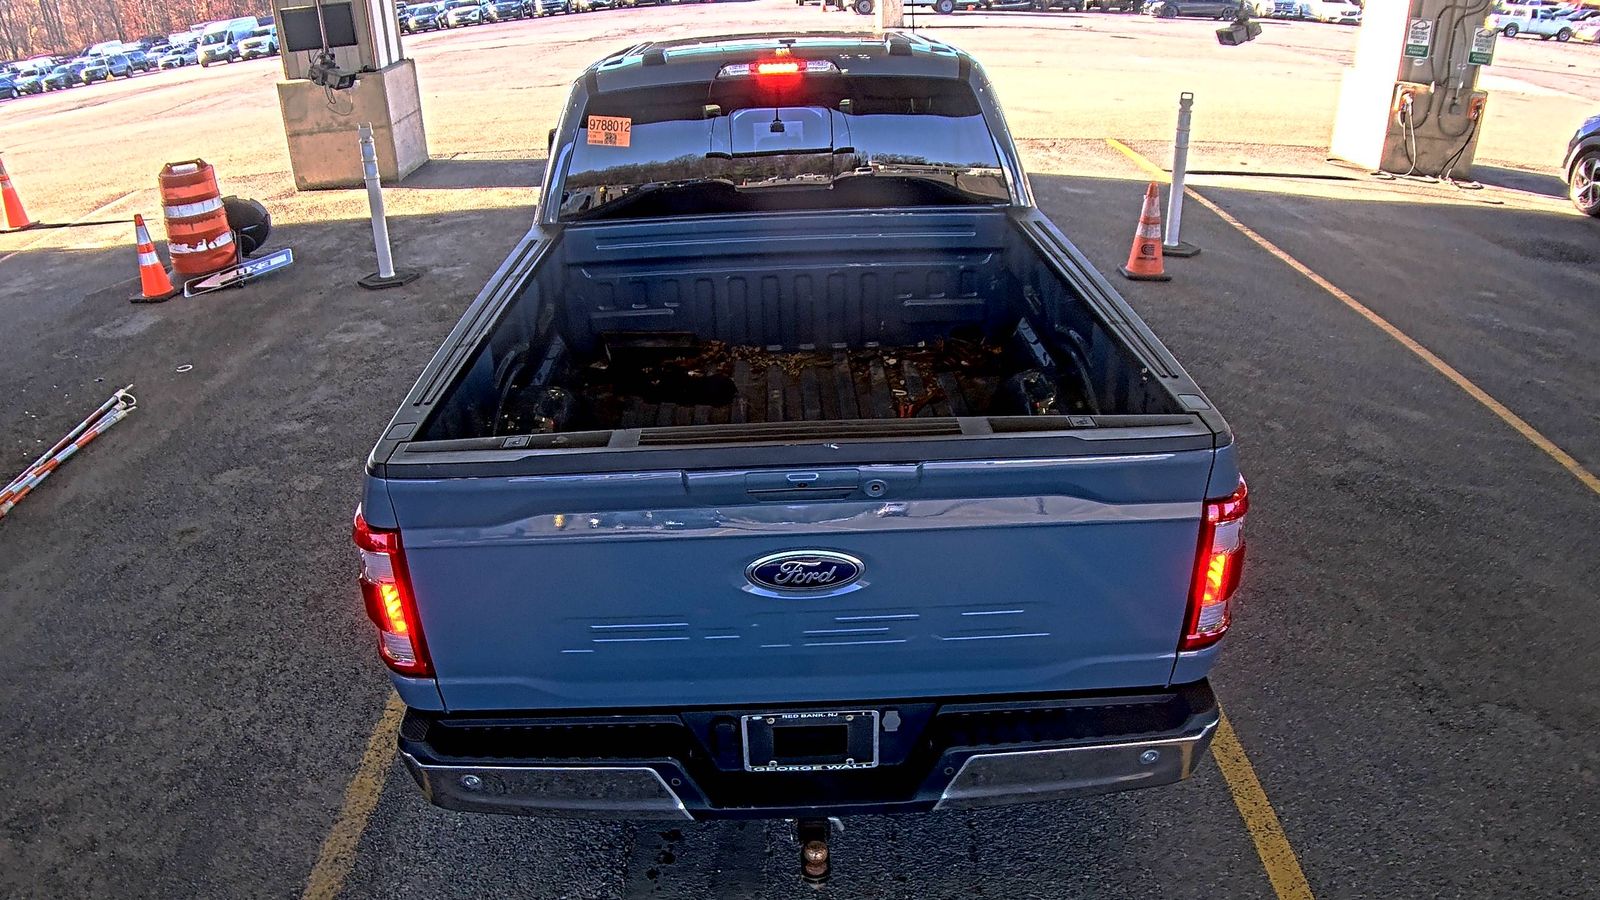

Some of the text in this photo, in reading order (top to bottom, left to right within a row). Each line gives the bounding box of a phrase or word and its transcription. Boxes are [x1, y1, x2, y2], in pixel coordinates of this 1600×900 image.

[590, 119, 630, 132] 9788012
[774, 560, 838, 584] Ford
[753, 762, 874, 772] GEORGE WALL
